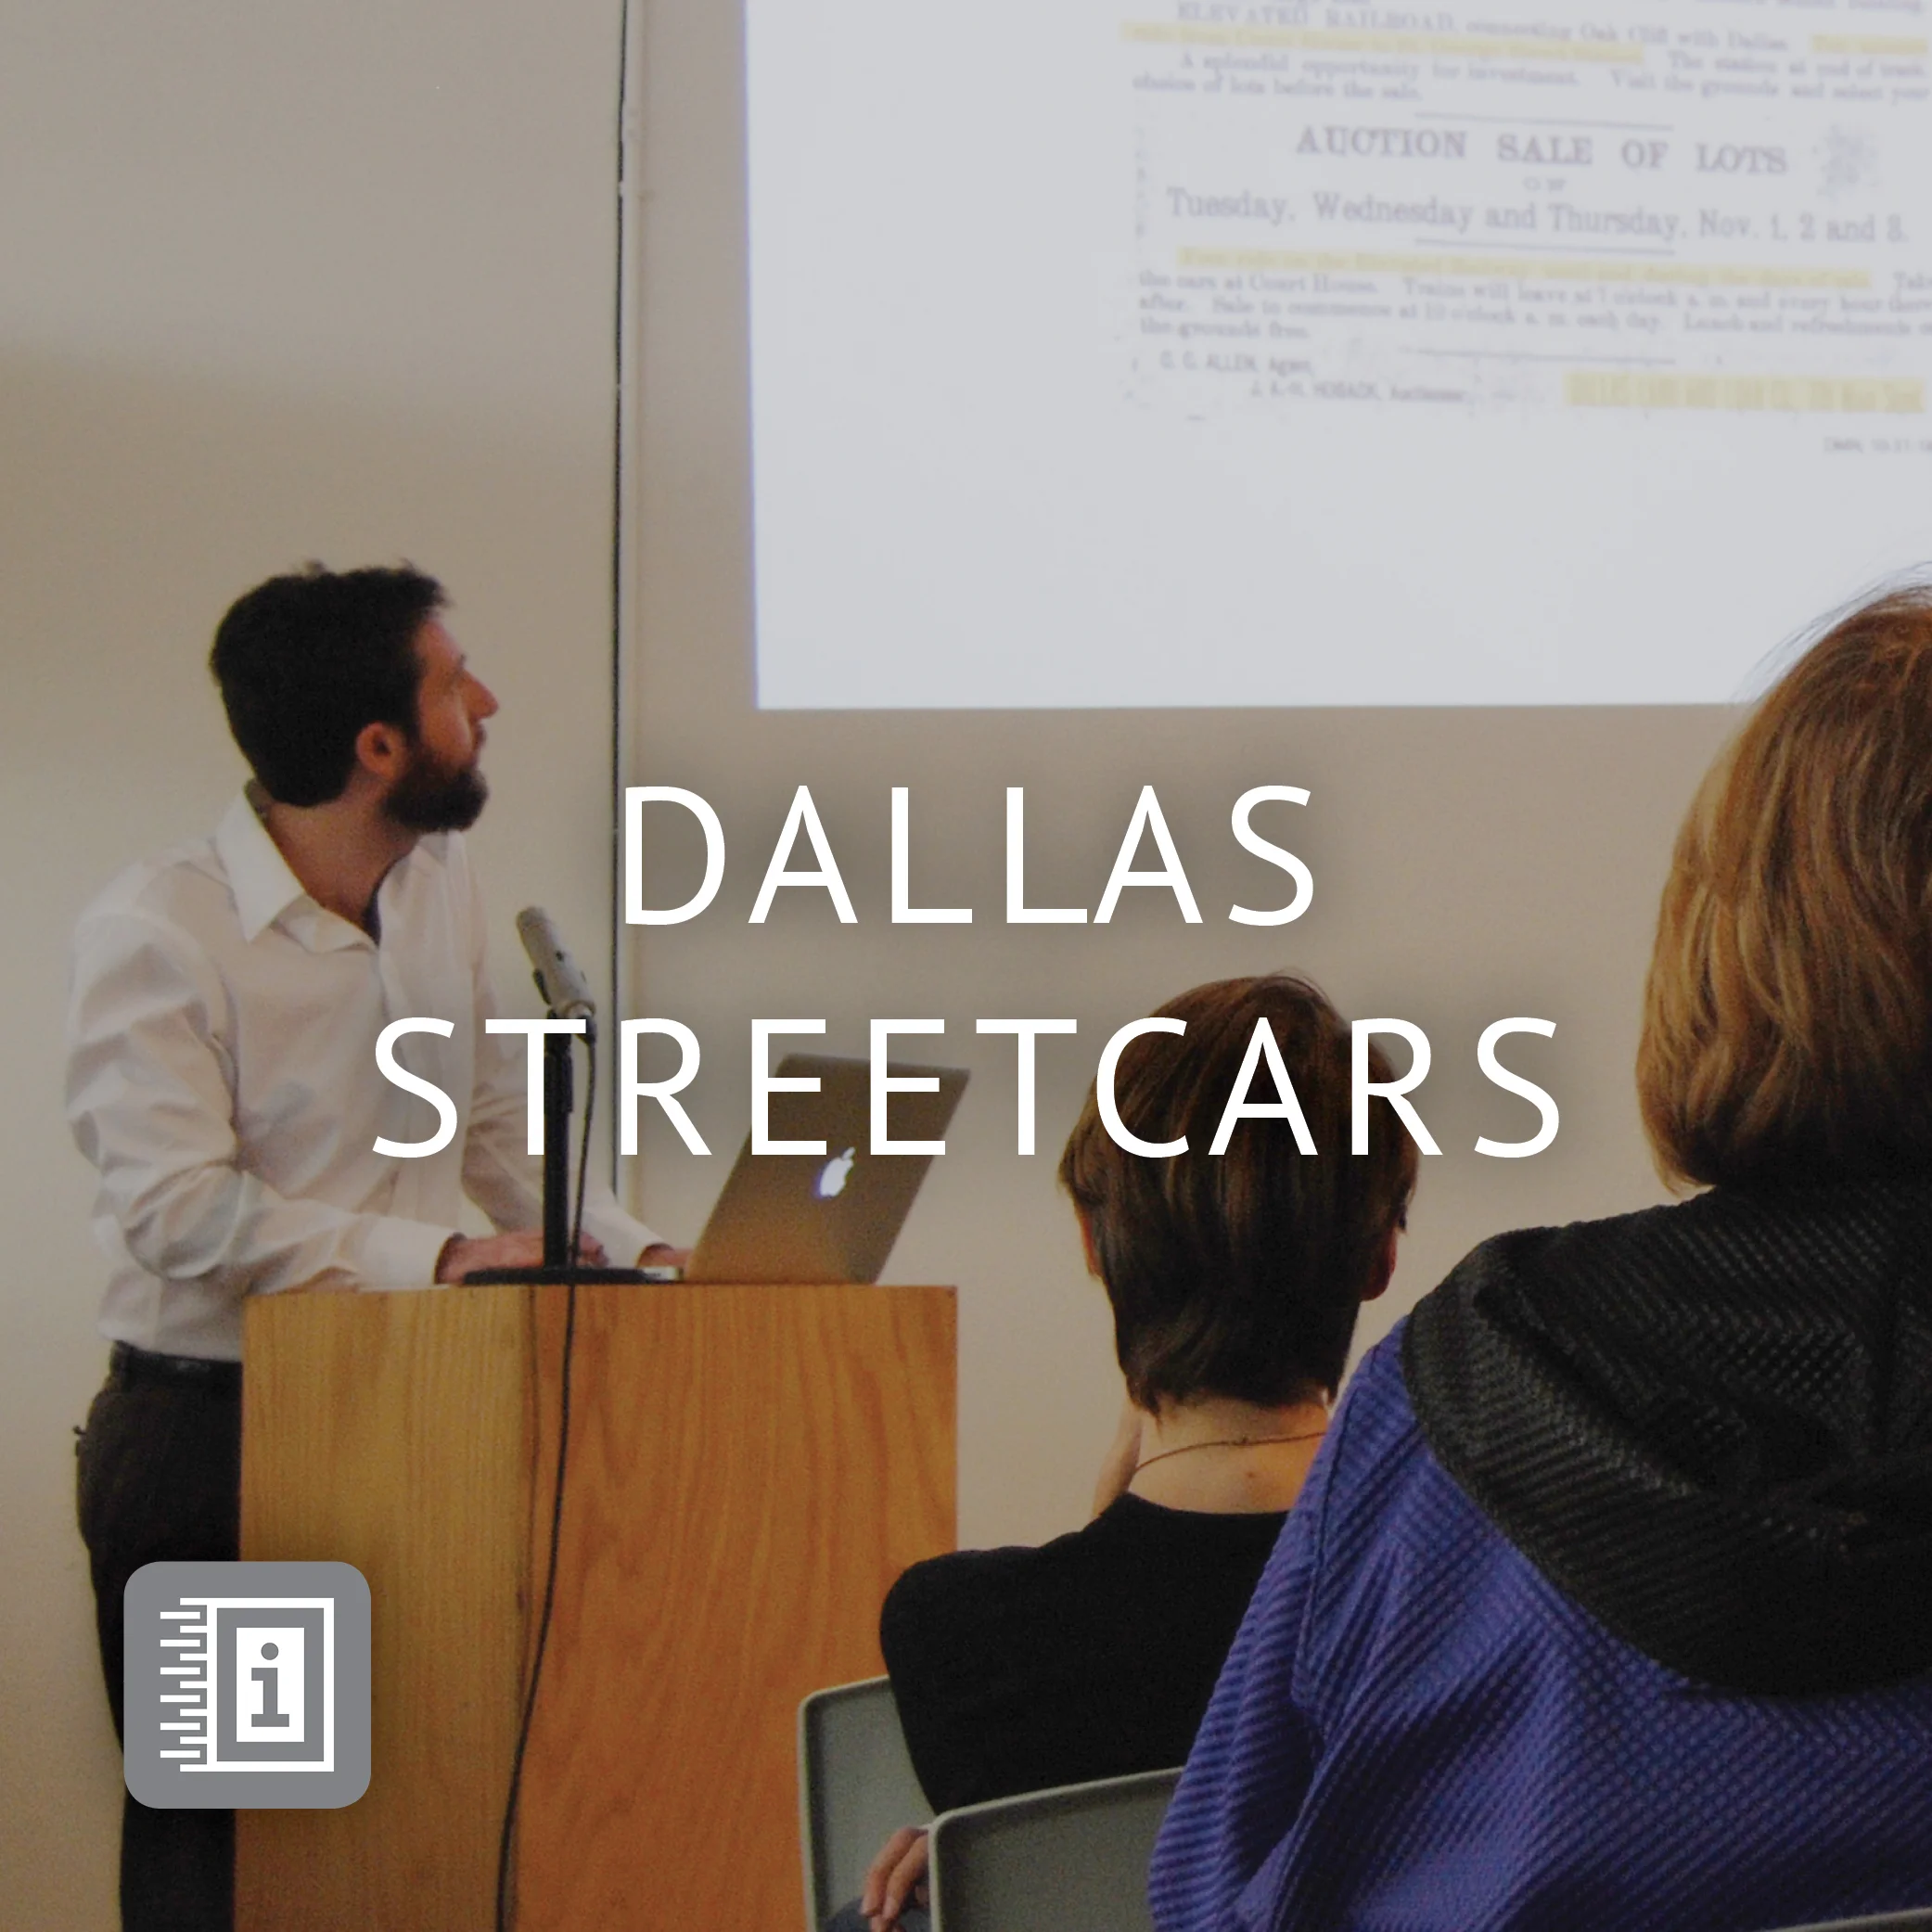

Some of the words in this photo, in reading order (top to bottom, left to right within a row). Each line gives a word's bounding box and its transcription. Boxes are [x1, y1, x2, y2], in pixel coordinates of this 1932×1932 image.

[1296, 125, 1467, 159] AUCTION
[1497, 131, 1593, 166] SALE
[1621, 139, 1670, 171] OF
[1695, 142, 1788, 174] LOTS
[1313, 191, 1475, 236] Wednesday
[1484, 201, 1536, 230] and
[1699, 209, 1759, 238] Nov.
[1799, 213, 1816, 241] 2
[1827, 213, 1875, 243] and
